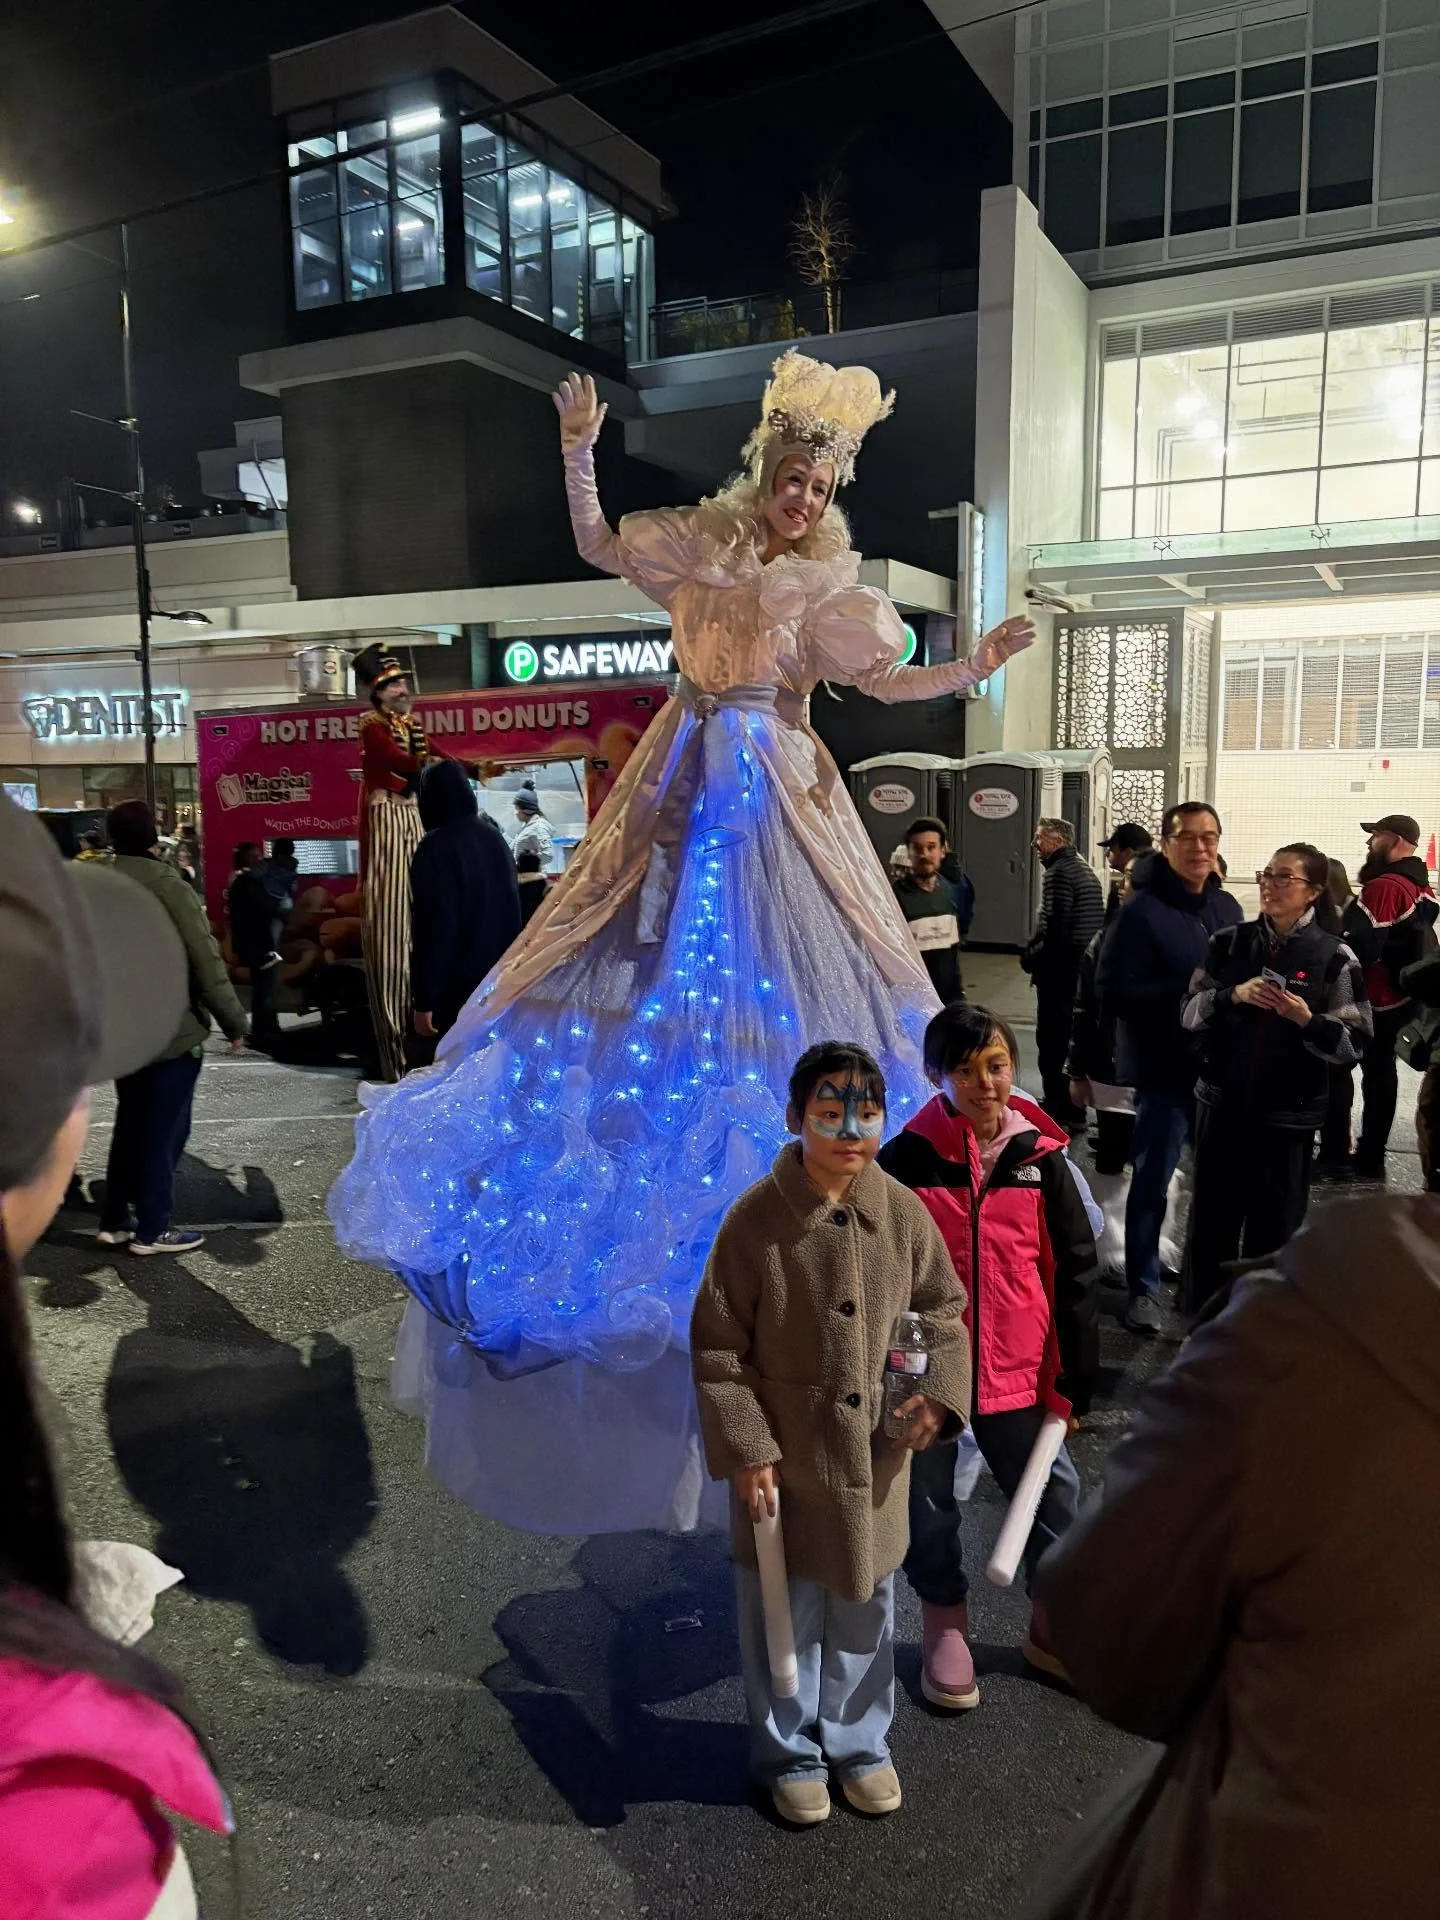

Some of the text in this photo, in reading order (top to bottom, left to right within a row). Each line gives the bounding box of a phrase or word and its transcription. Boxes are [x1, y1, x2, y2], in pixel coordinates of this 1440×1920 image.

[543, 640, 674, 676] SAFEWAY
[261, 719, 309, 744] HOT
[315, 716, 360, 740] FRE
[472, 701, 590, 731] DONUTS
[264, 818, 295, 832] WATCH
[295, 816, 311, 827] THE
[313, 816, 350, 830] DONUTS
